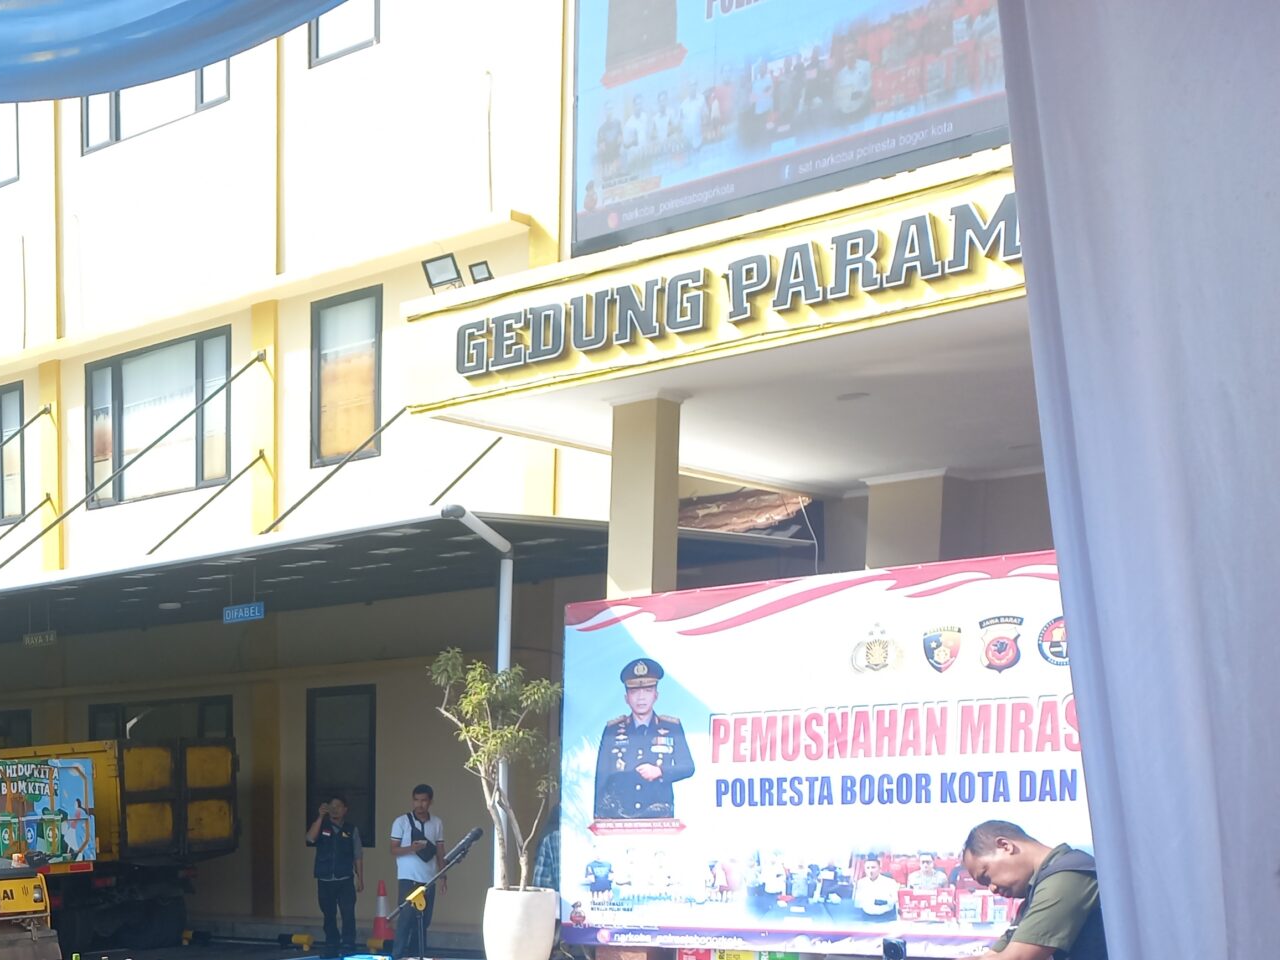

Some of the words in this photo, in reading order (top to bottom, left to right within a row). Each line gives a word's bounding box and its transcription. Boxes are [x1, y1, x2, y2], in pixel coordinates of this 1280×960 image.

[931, 120, 953, 138] kota
[455, 267, 708, 377] GEDUNG
[225, 606, 261, 620] DIFABEL
[1000, 615, 1022, 625] BARAT
[710, 704, 949, 764] PEMUSNAHAN
[958, 697, 1082, 756] MIRAS
[715, 776, 834, 808] POLRESTA
[840, 773, 932, 805] BOGOR
[940, 770, 1012, 804] KOTA
[1018, 768, 1078, 802] DAN
